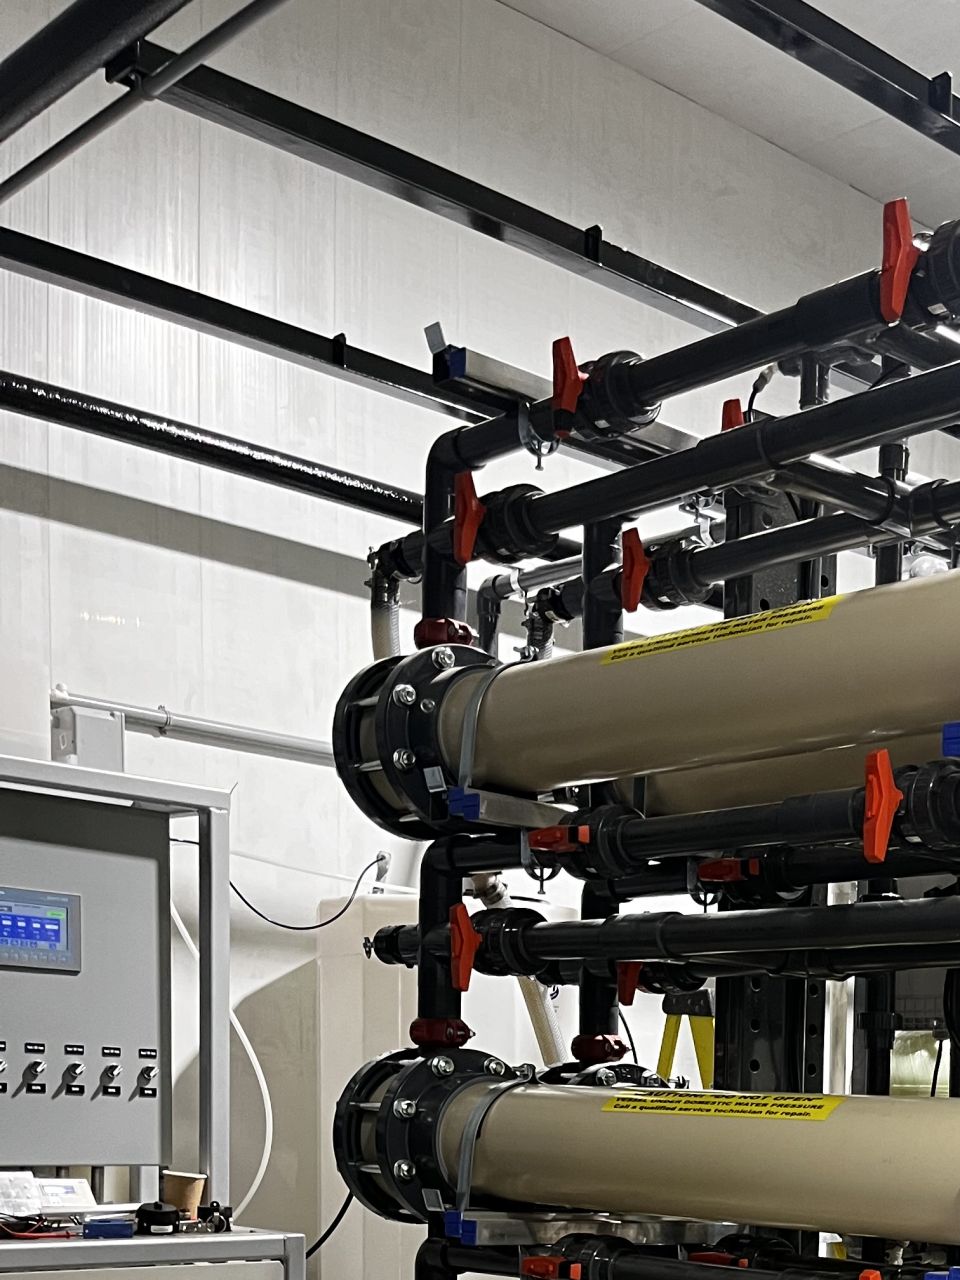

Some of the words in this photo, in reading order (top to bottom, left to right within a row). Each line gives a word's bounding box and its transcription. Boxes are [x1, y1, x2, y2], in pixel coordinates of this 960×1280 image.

[713, 625, 762, 639] technician
[769, 1102, 825, 1110] PRESSURE
[780, 1110, 812, 1118] repair.
